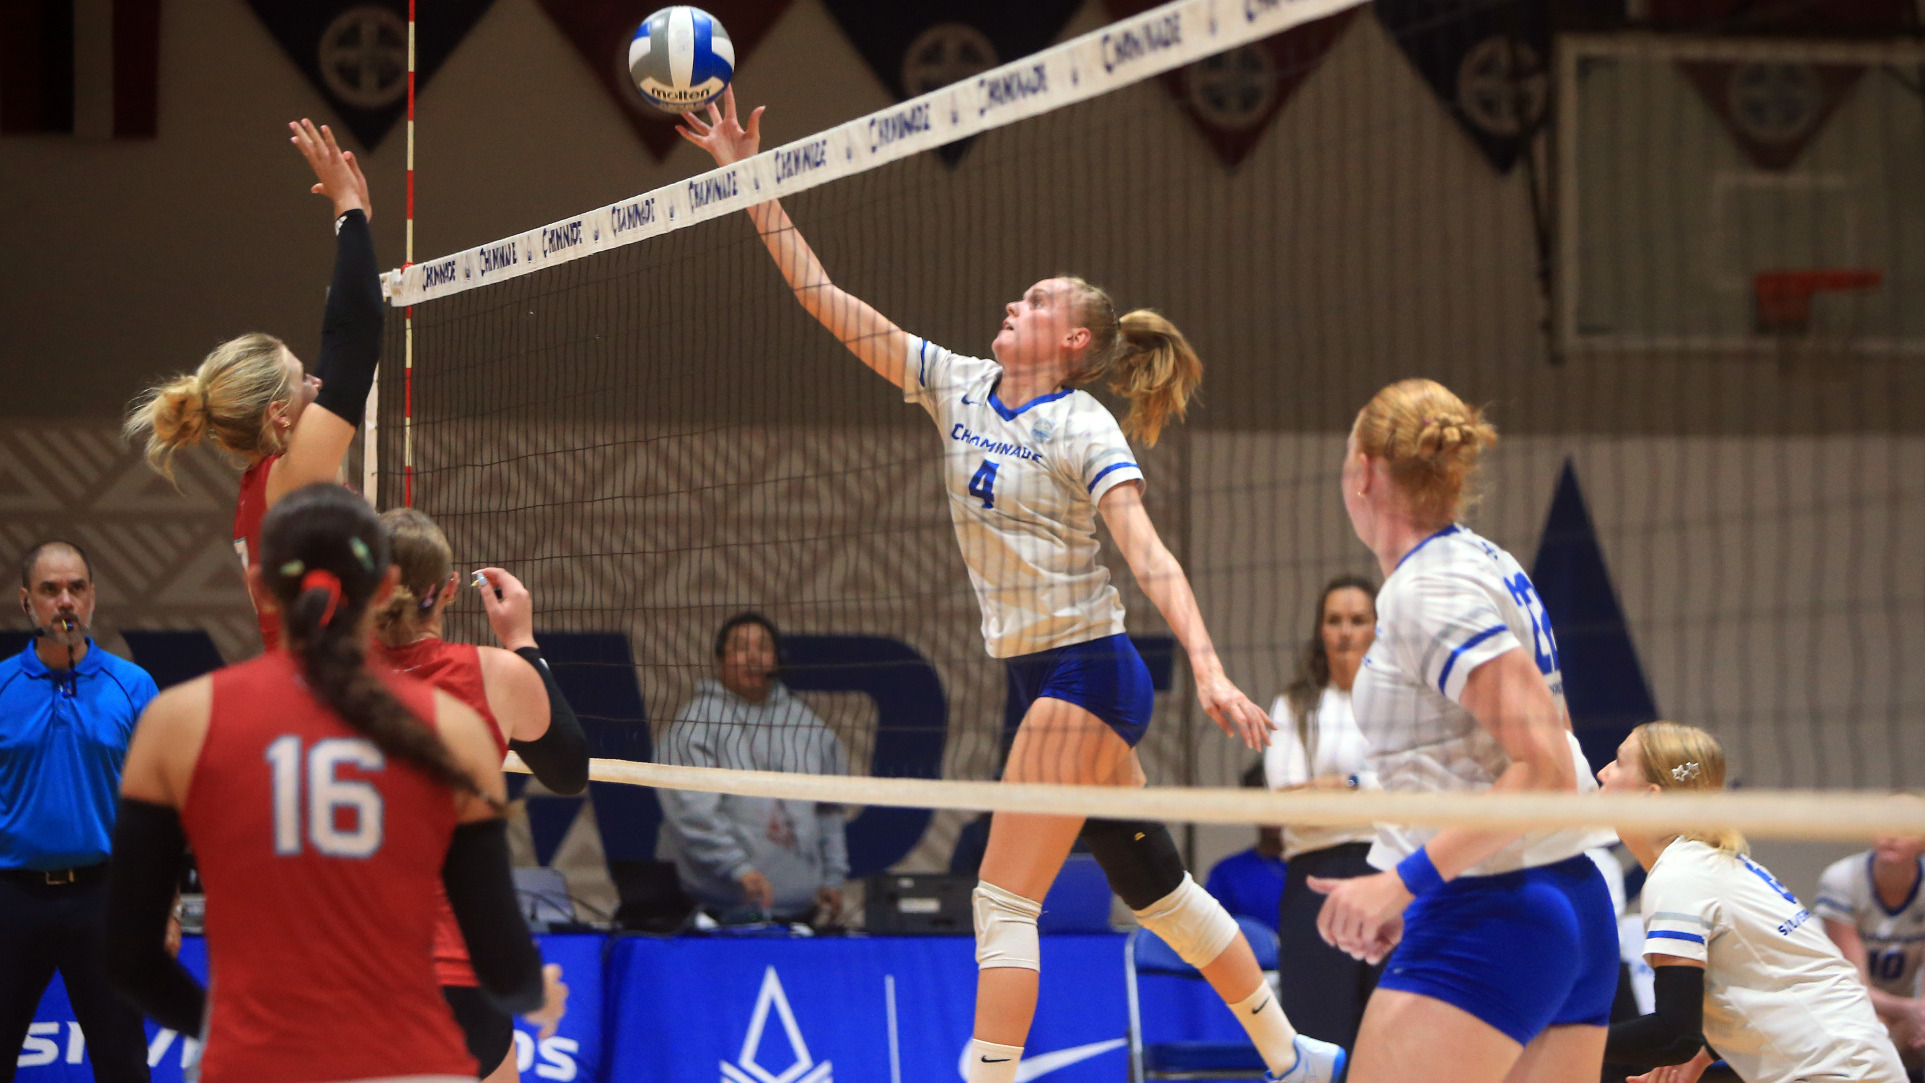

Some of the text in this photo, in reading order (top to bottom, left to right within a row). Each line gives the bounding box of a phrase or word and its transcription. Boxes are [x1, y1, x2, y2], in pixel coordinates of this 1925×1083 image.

[651, 87, 711, 100] molten
[951, 423, 1043, 464] CHAMINADE
[968, 458, 1000, 509] 4
[265, 734, 387, 860] 16
